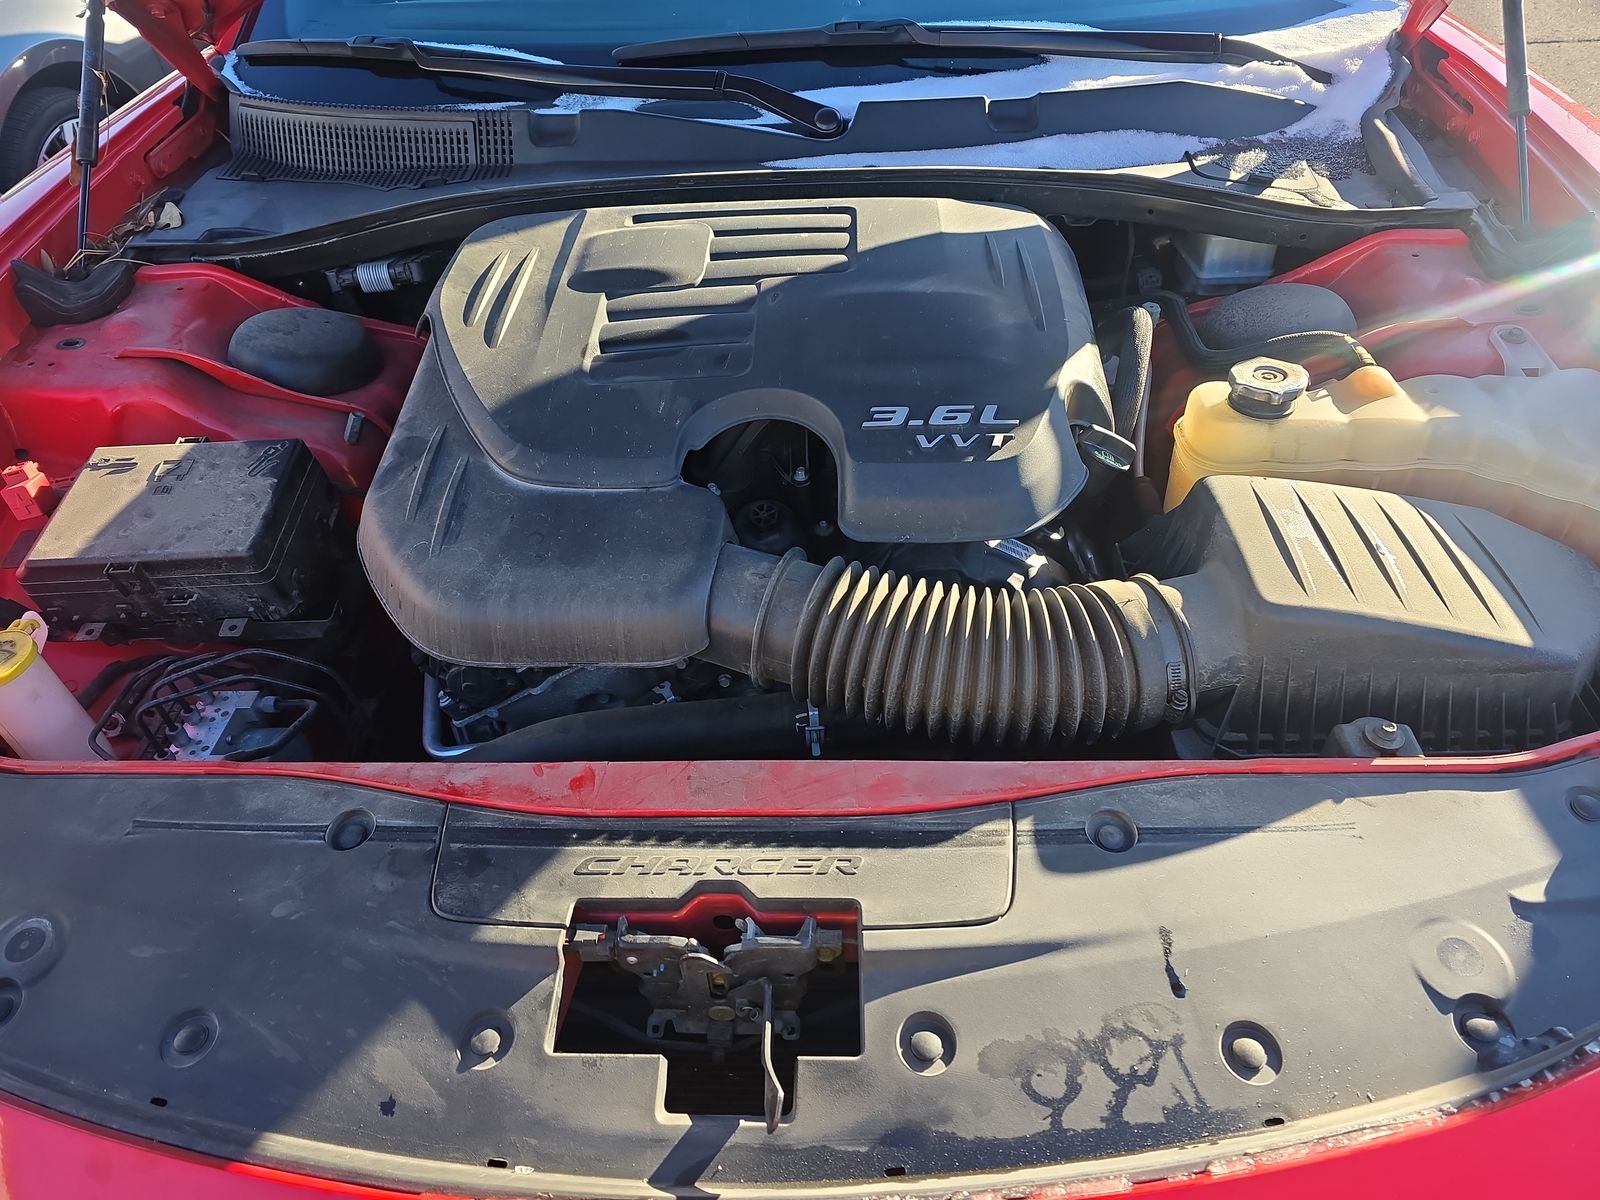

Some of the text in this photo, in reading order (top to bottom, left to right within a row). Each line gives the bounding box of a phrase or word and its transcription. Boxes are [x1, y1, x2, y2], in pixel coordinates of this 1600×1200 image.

[861, 404, 1020, 429] 3.6L
[916, 433, 1016, 449] VVT
[573, 855, 863, 876] CHARGER
